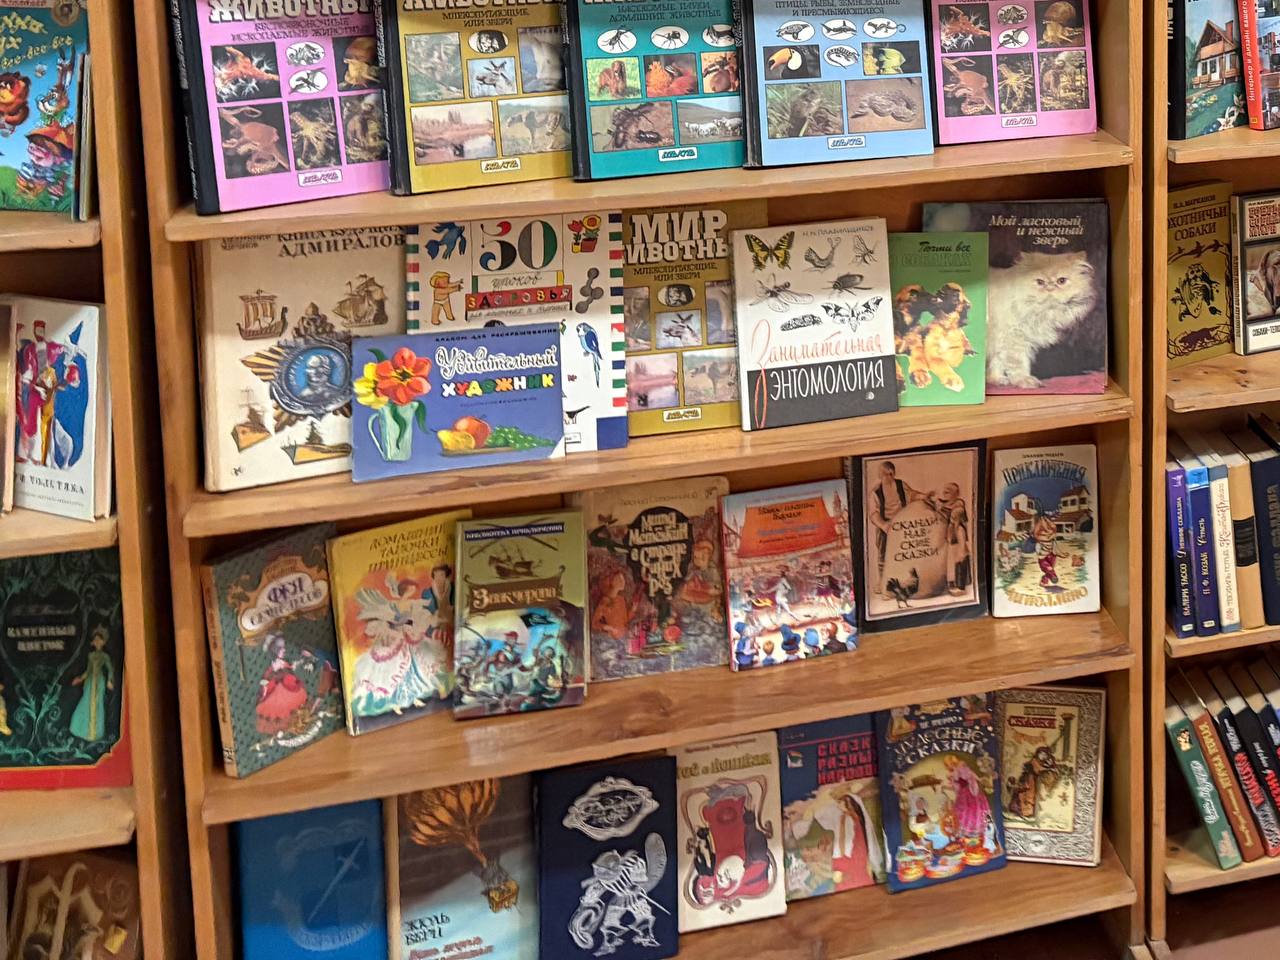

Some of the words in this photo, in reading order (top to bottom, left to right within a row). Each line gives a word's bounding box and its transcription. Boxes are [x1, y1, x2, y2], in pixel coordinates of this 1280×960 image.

[630, 209, 728, 244] МИР
[989, 215, 1017, 228] Мой
[1018, 215, 1082, 228] ласковый
[1016, 227, 1026, 235] и
[1028, 225, 1085, 237] нежный
[1174, 222, 1217, 241] СОБАКИ
[278, 233, 407, 258] АДМИРАЛОВ
[478, 220, 558, 271] 50
[1032, 235, 1069, 248] зверь
[752, 318, 883, 368] Занимательная
[436, 345, 558, 379] Удивительный
[440, 373, 556, 398] ХУДОЖНИК
[770, 358, 885, 402] ЭНТОМОЛОГИЯ
[1002, 460, 1087, 485] ПРИКЛЮЧЕНИЯ
[894, 548, 939, 562] СКАЗКИ
[906, 742, 976, 766] СКАЗКИ
